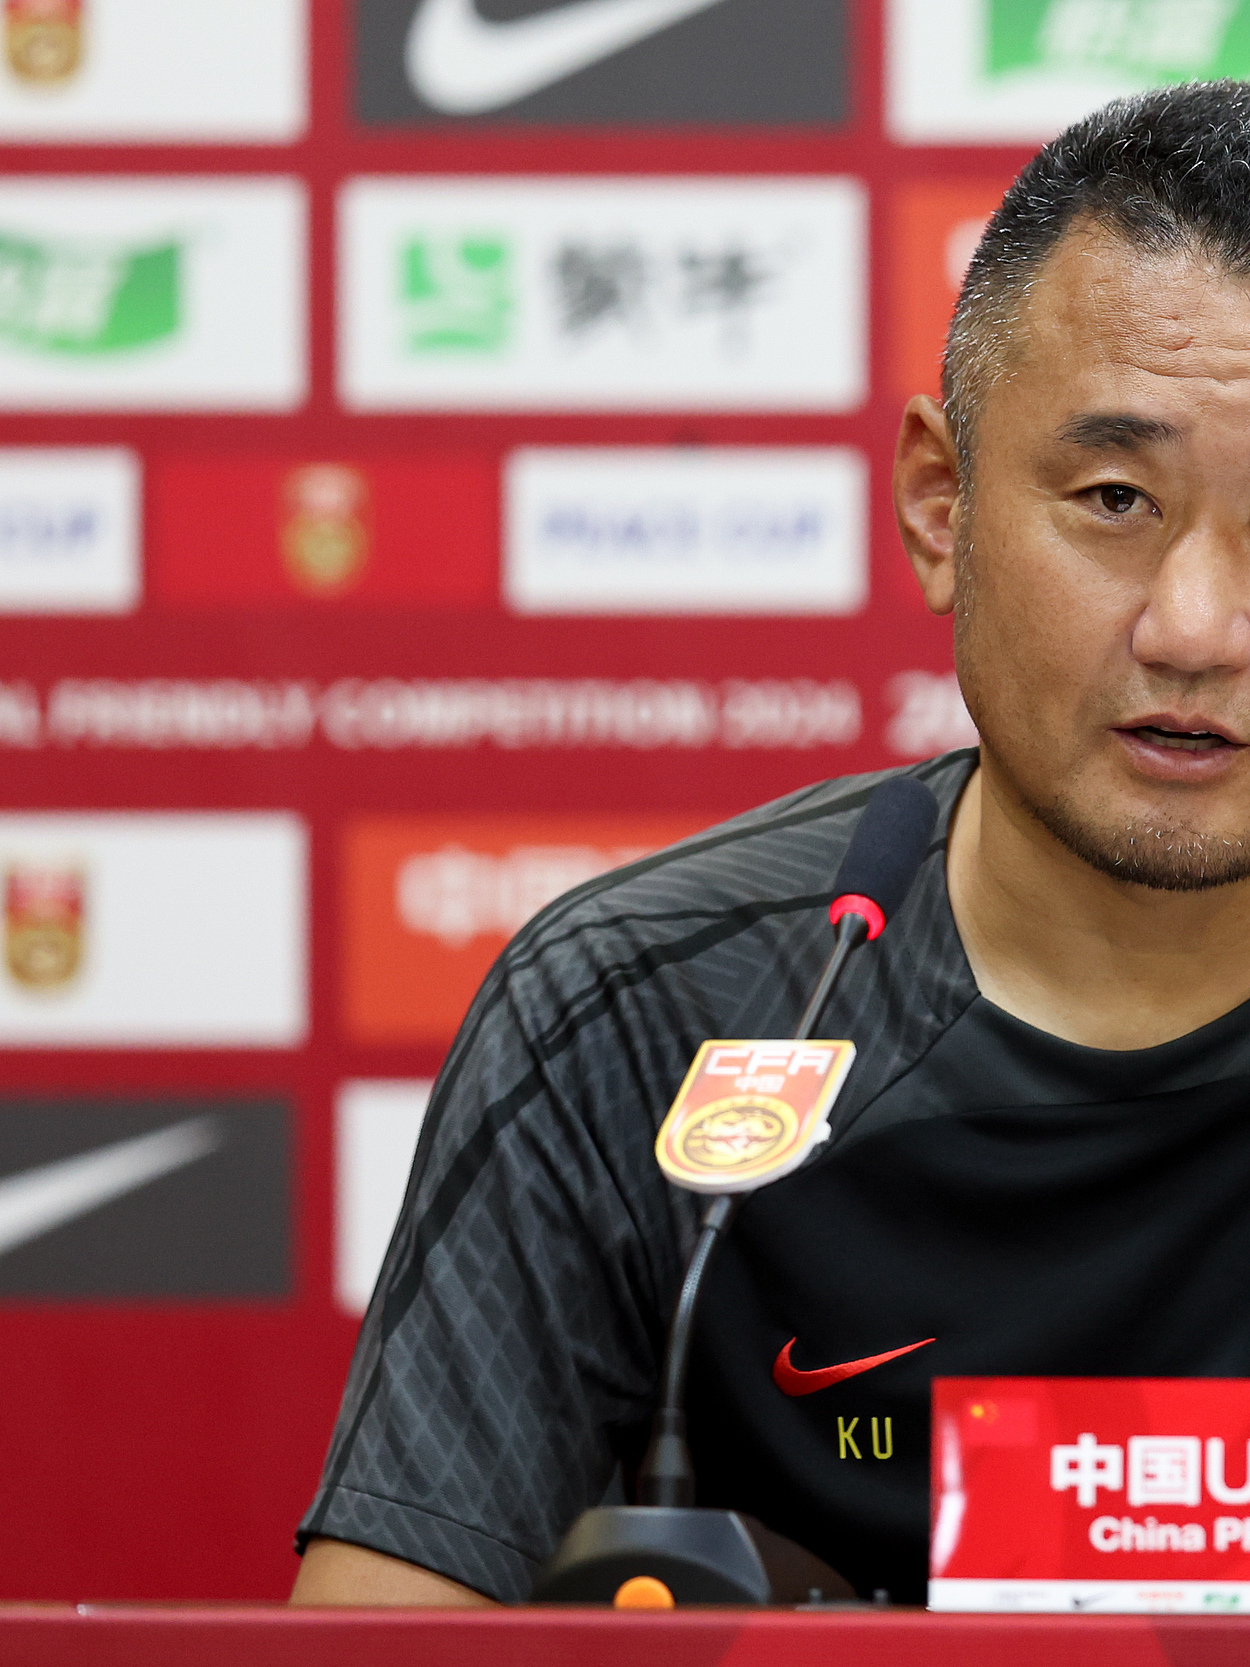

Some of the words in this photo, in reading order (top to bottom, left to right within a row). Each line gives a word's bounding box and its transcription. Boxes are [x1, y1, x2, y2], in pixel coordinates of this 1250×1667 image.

[705, 1049, 834, 1076] CFA
[734, 1073, 785, 1094] 中国
[1089, 1515, 1206, 1552] China
